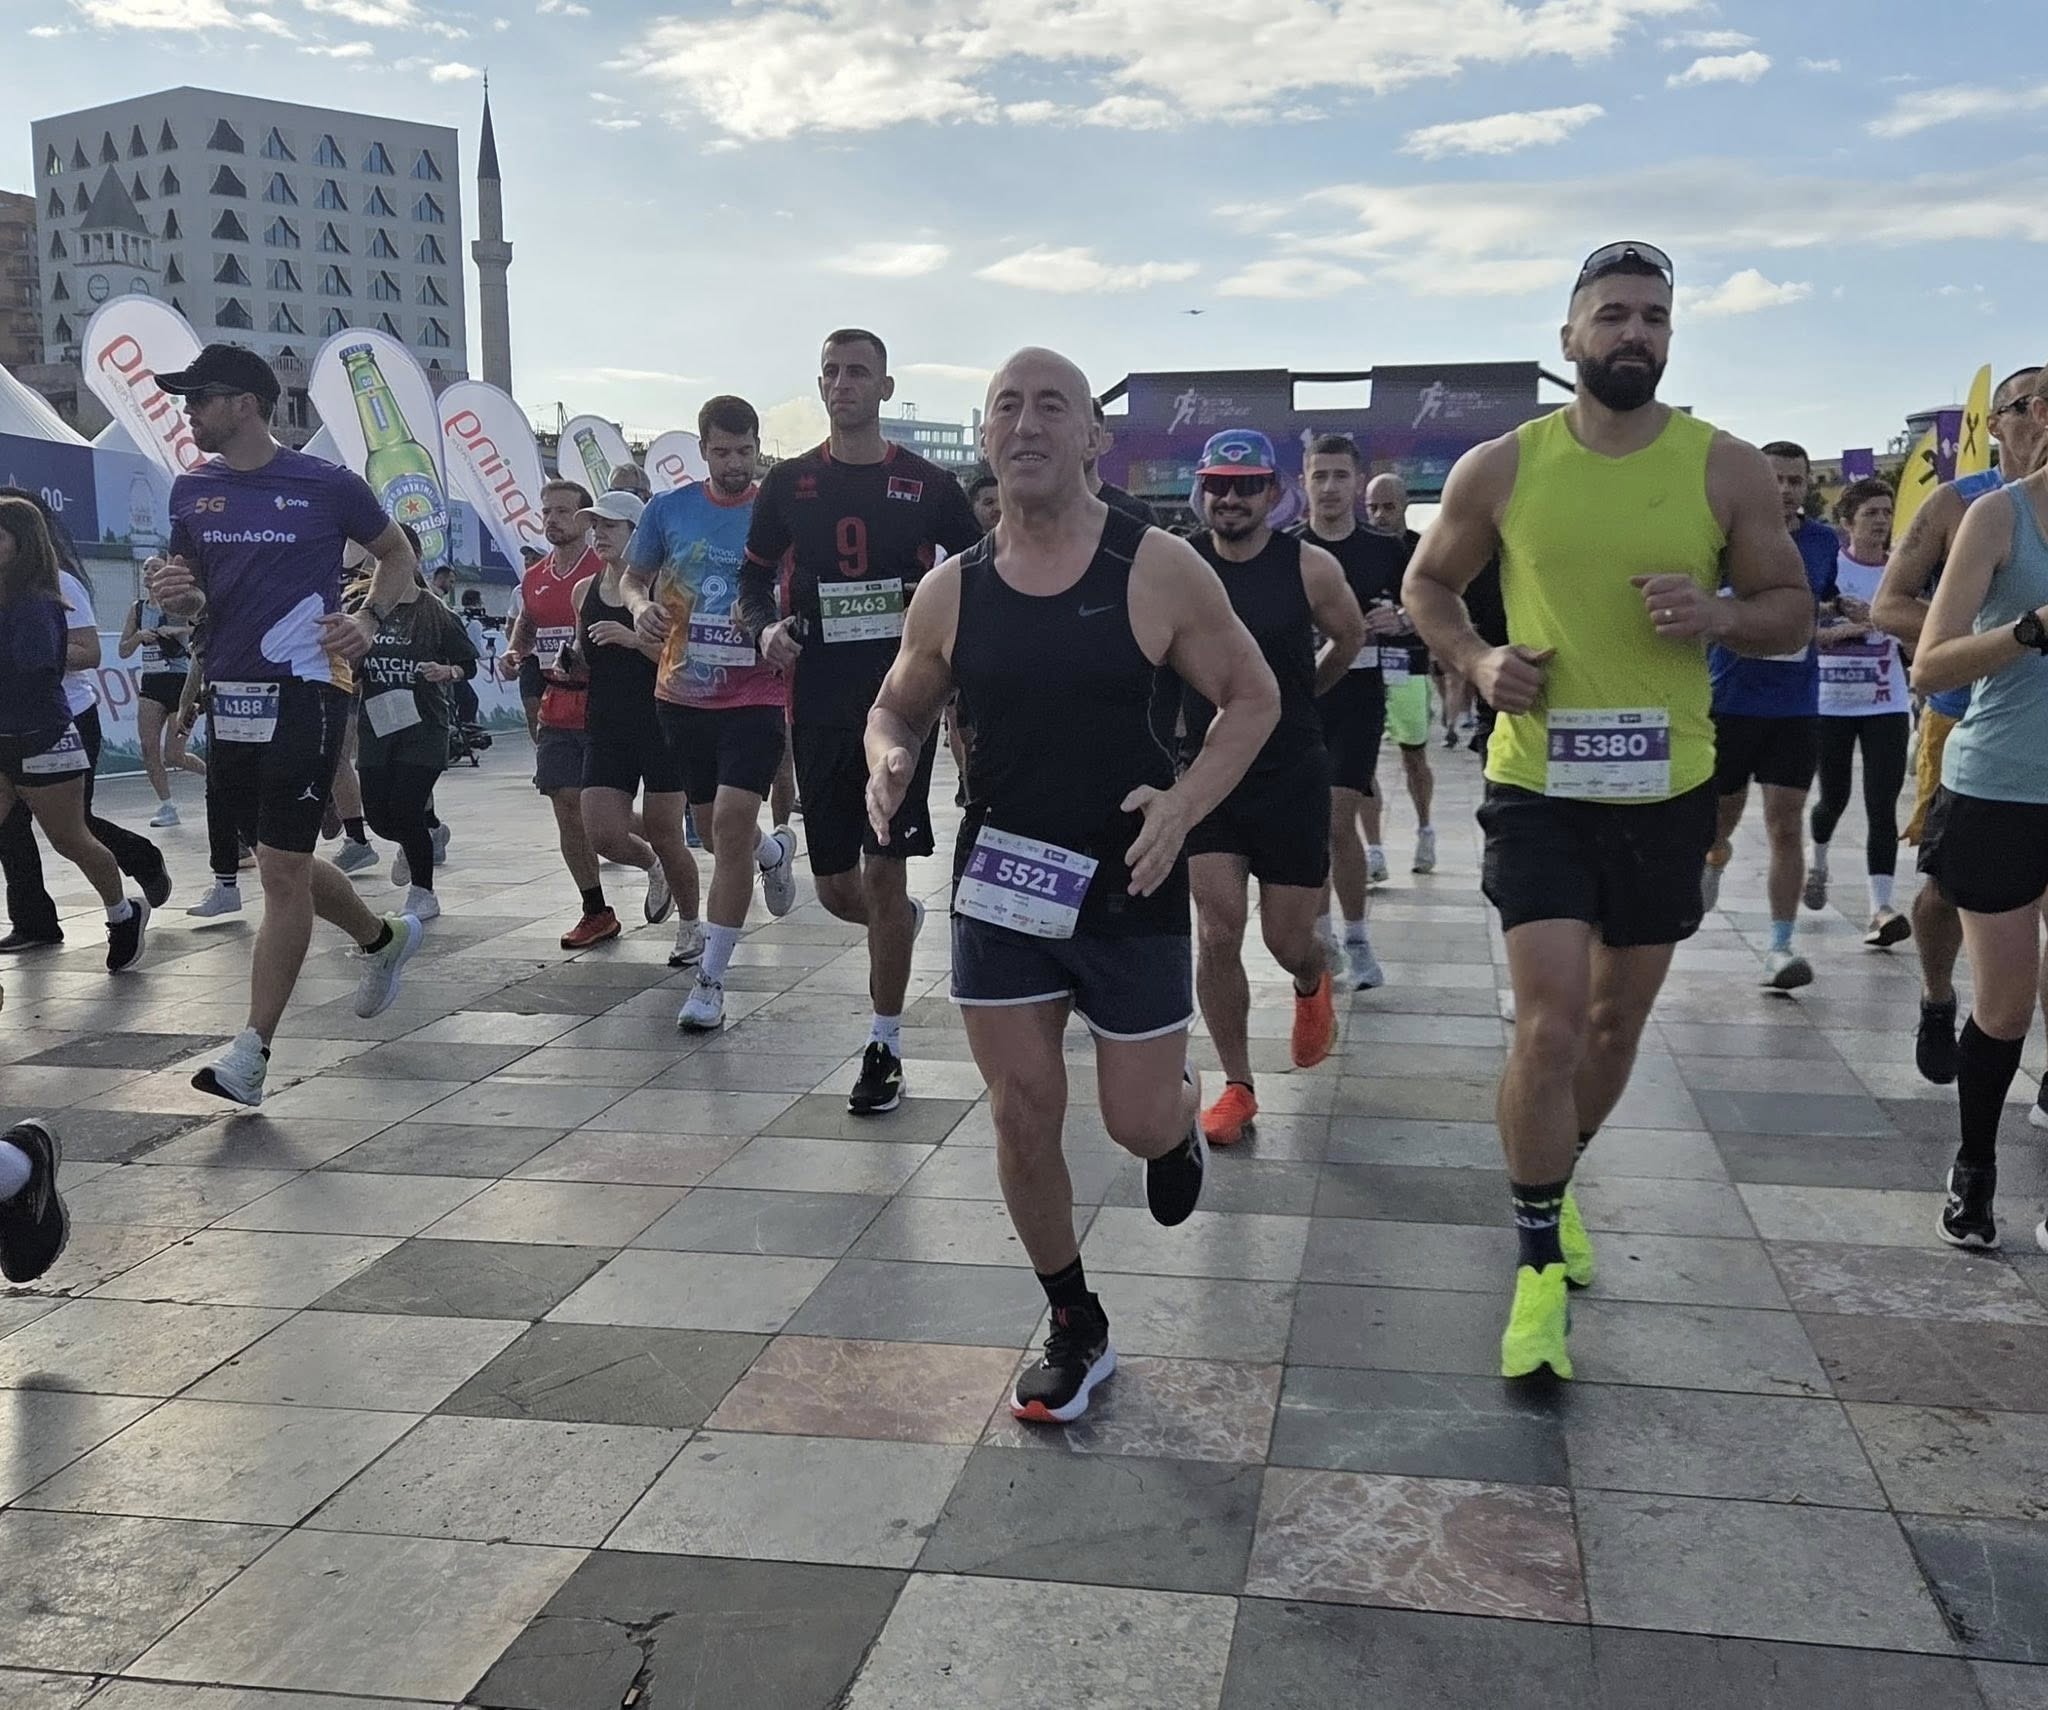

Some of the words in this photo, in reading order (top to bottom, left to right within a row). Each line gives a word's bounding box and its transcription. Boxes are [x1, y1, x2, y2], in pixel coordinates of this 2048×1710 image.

[195, 496, 226, 513] 5G
[286, 499, 309, 508] one
[203, 530, 296, 543] #RunAsOne
[836, 517, 868, 578] 9
[840, 597, 886, 615] 2463
[704, 628, 743, 644] 5426
[369, 670, 416, 683] LATTE
[225, 700, 262, 715] 4188
[1574, 734, 1648, 757] 5380
[996, 858, 1058, 896] 5521
